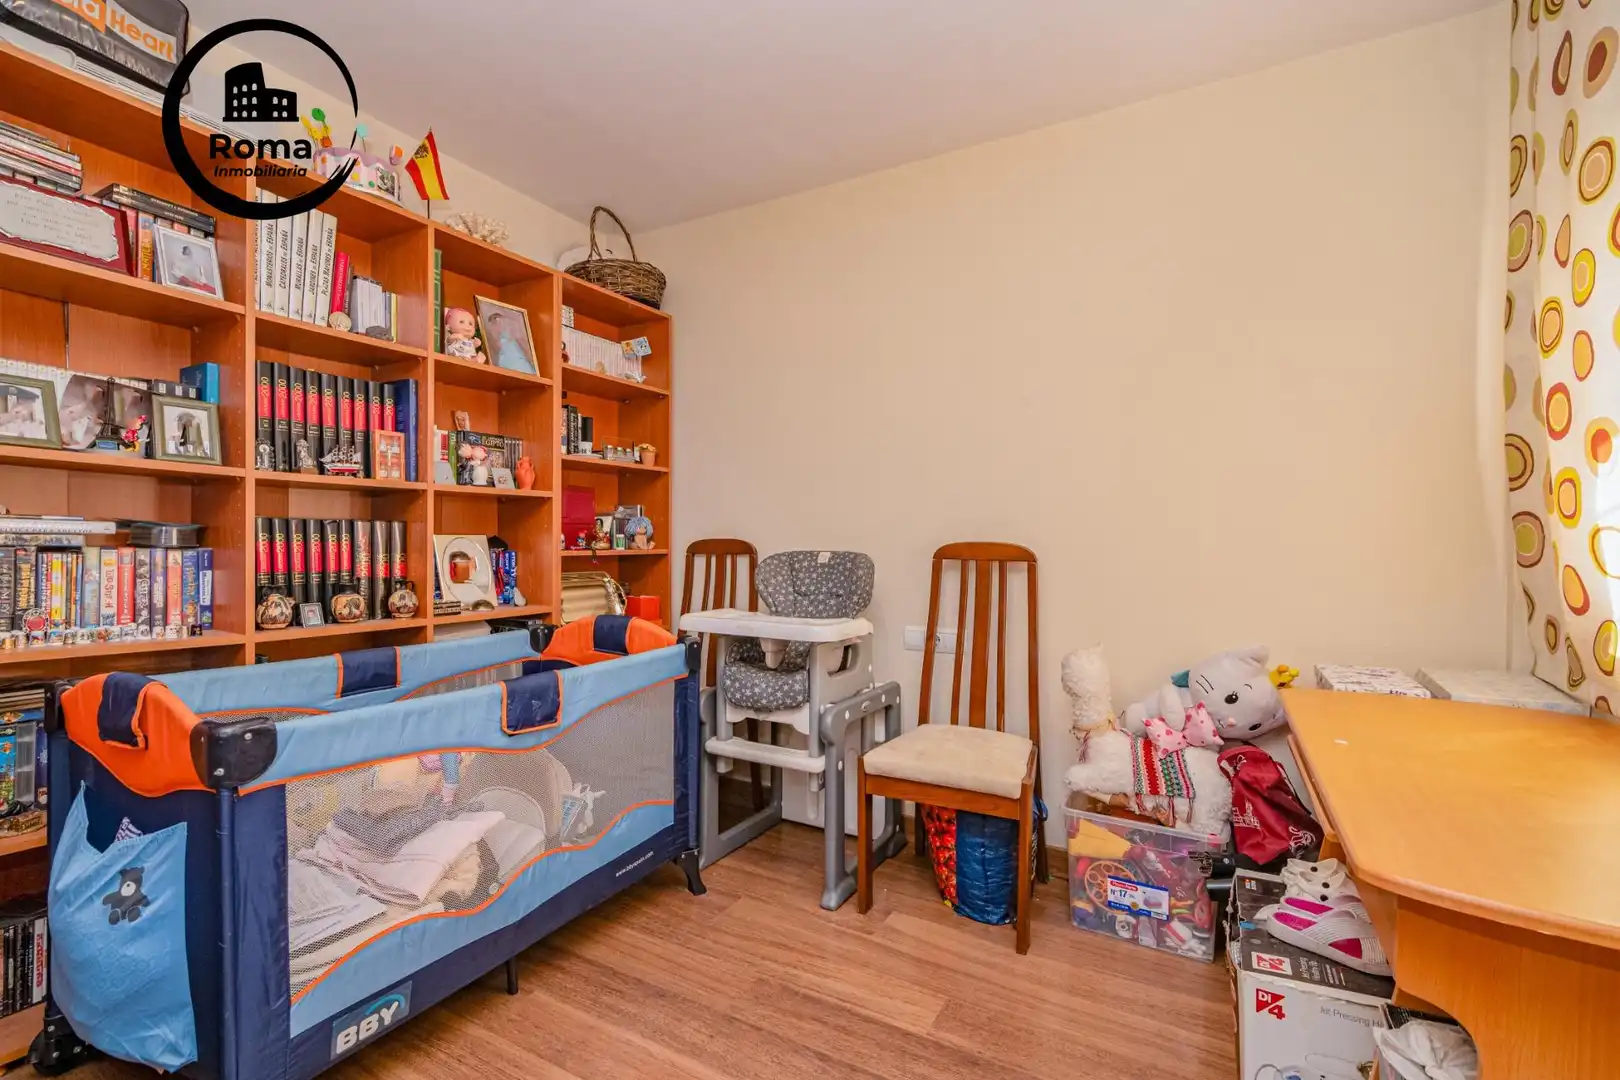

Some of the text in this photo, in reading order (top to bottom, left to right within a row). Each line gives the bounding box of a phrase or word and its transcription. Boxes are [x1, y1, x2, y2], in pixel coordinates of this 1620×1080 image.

[110, 9, 174, 61] Heart
[1119, 889, 1127, 897] 17
[1258, 990, 1272, 1003] DI
[1268, 1004, 1286, 1020] 4
[1333, 1008, 1370, 1027] Pressing
[336, 1000, 399, 1054] BBY
